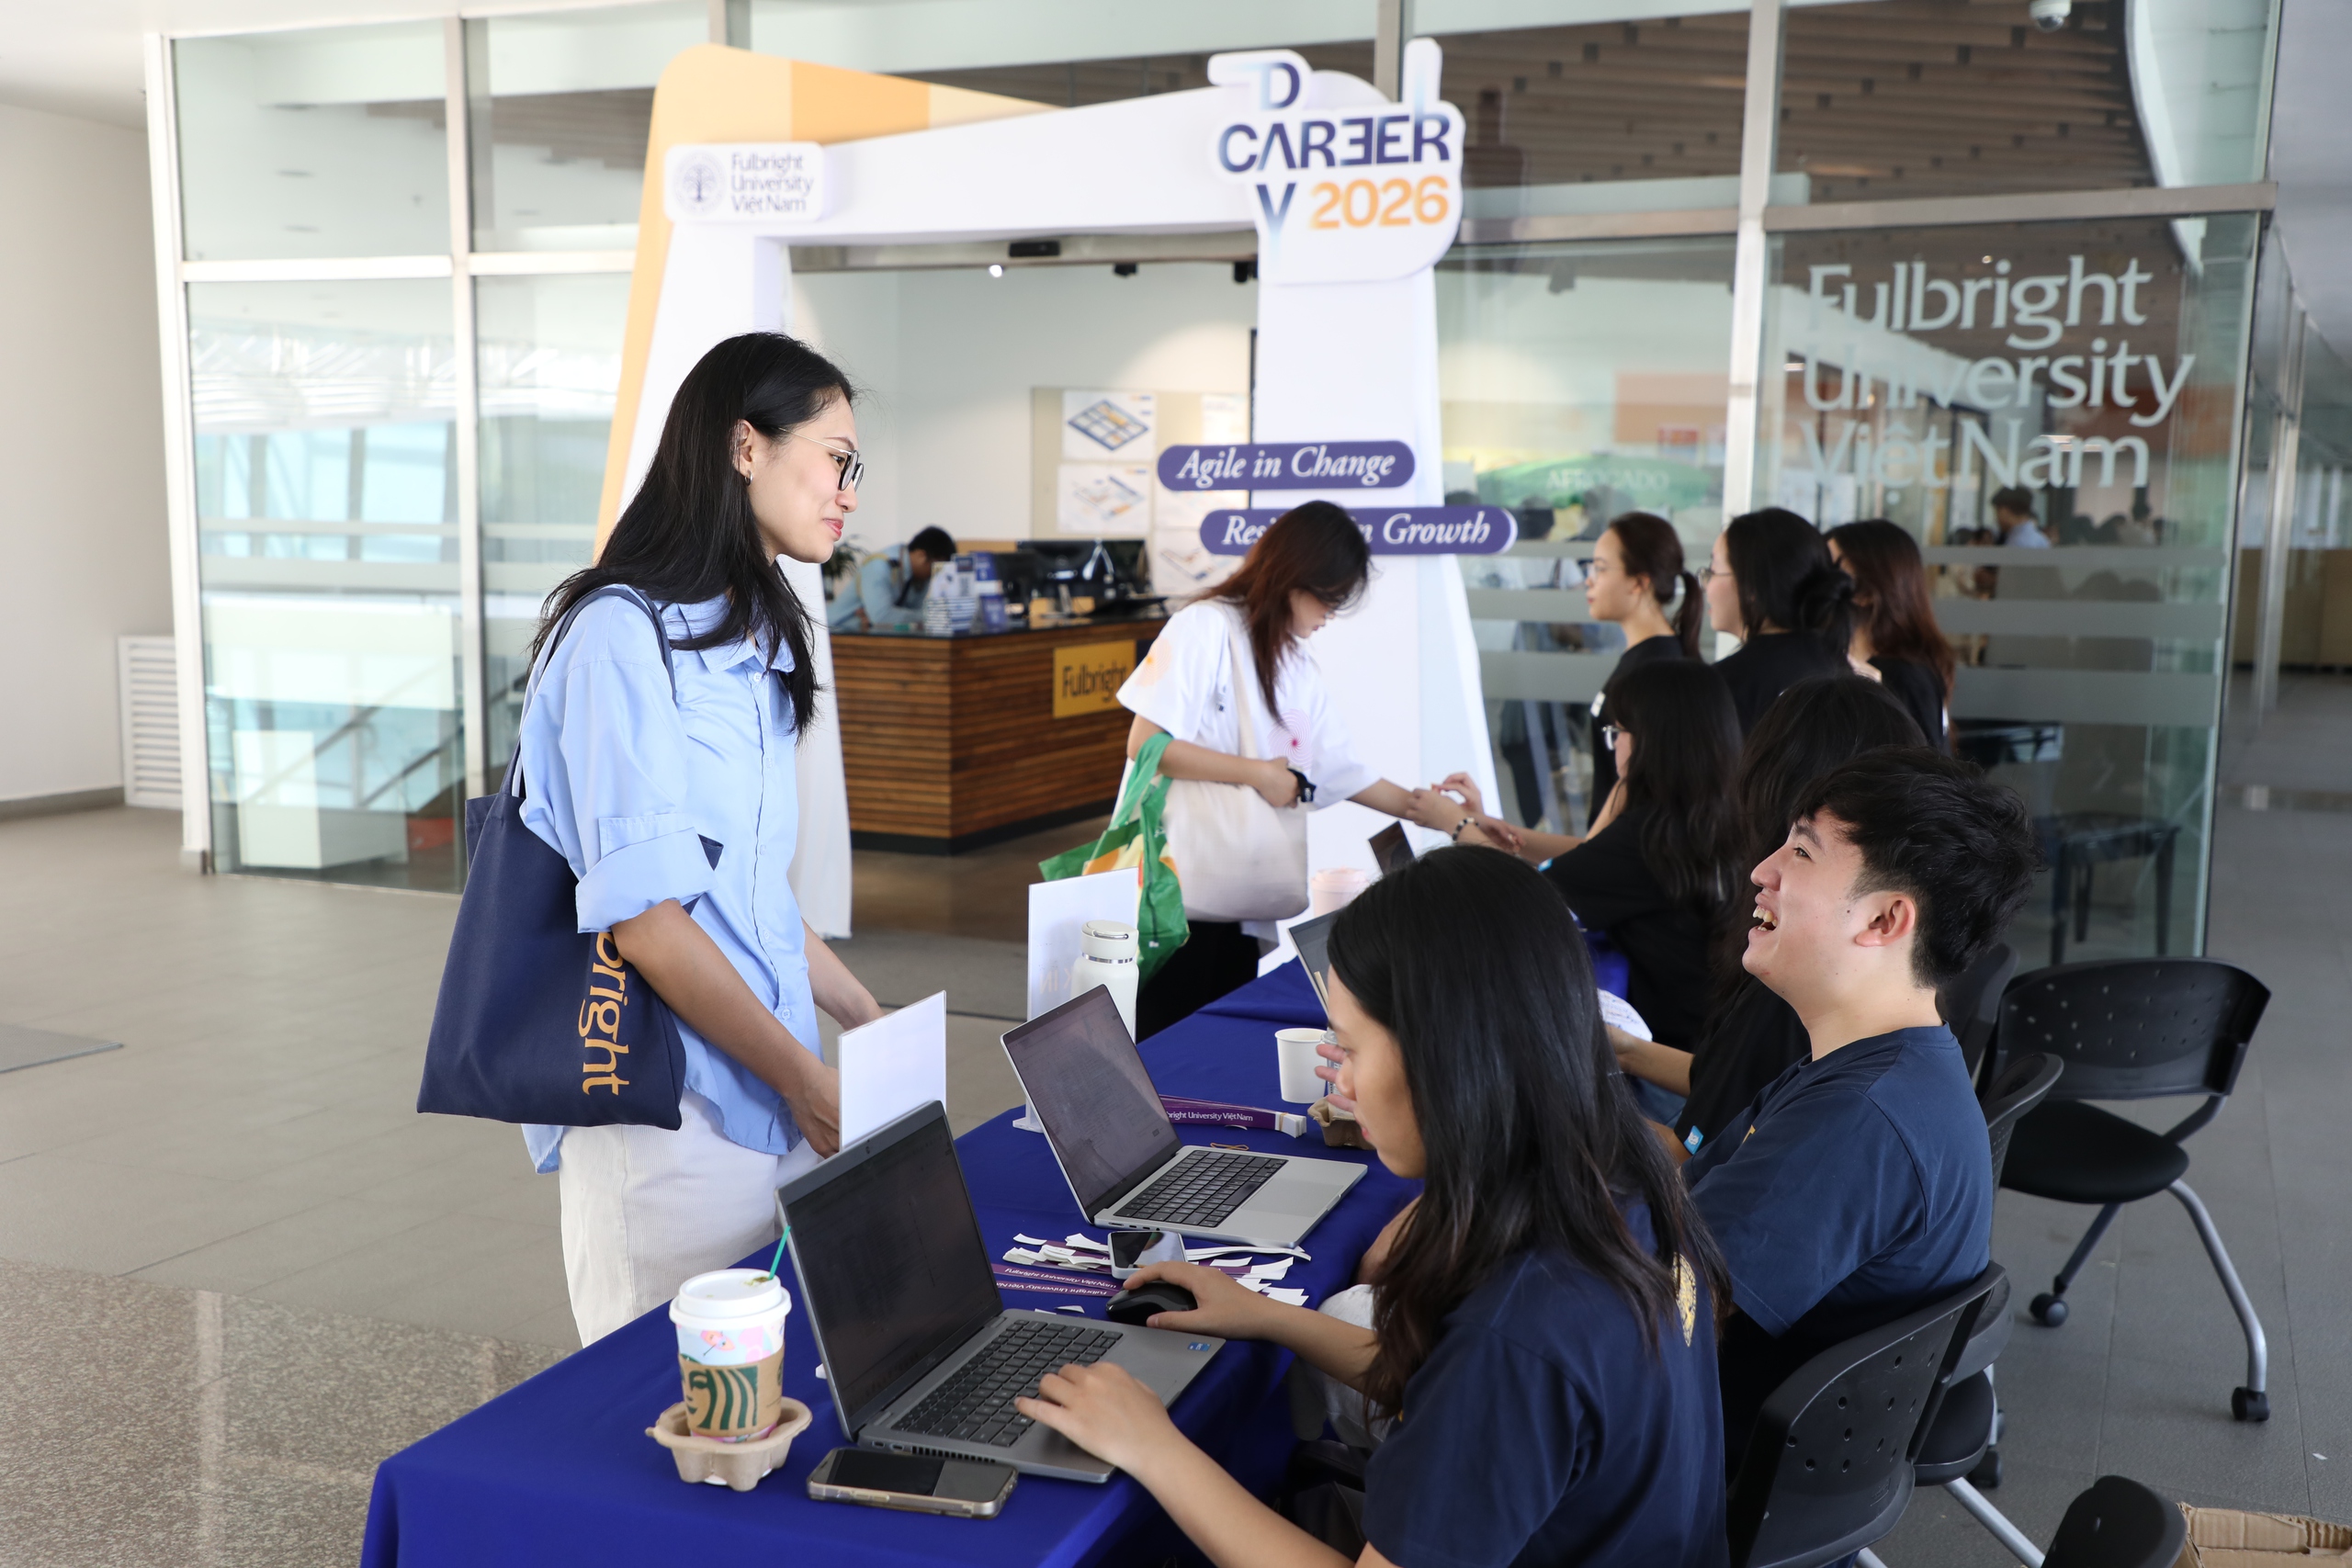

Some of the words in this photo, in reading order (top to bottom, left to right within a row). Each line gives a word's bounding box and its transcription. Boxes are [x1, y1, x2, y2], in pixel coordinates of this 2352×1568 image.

[730, 152, 804, 176] Fulbright
[730, 174, 815, 197] University
[1308, 175, 1451, 231] 2026
[1807, 254, 2154, 351] Fulbright
[1803, 336, 2197, 428] University
[1176, 446, 1248, 488] Agile
[1252, 449, 1283, 479] in
[1291, 444, 1396, 486] Change
[1383, 510, 1492, 546] Growth
[1062, 660, 1126, 704] Fulbright
[1167, 1111, 1187, 1121] bright
[1188, 1111, 1222, 1122] University
[1004, 1268, 1040, 1279] Fulbright
[1040, 1273, 1080, 1283] University
